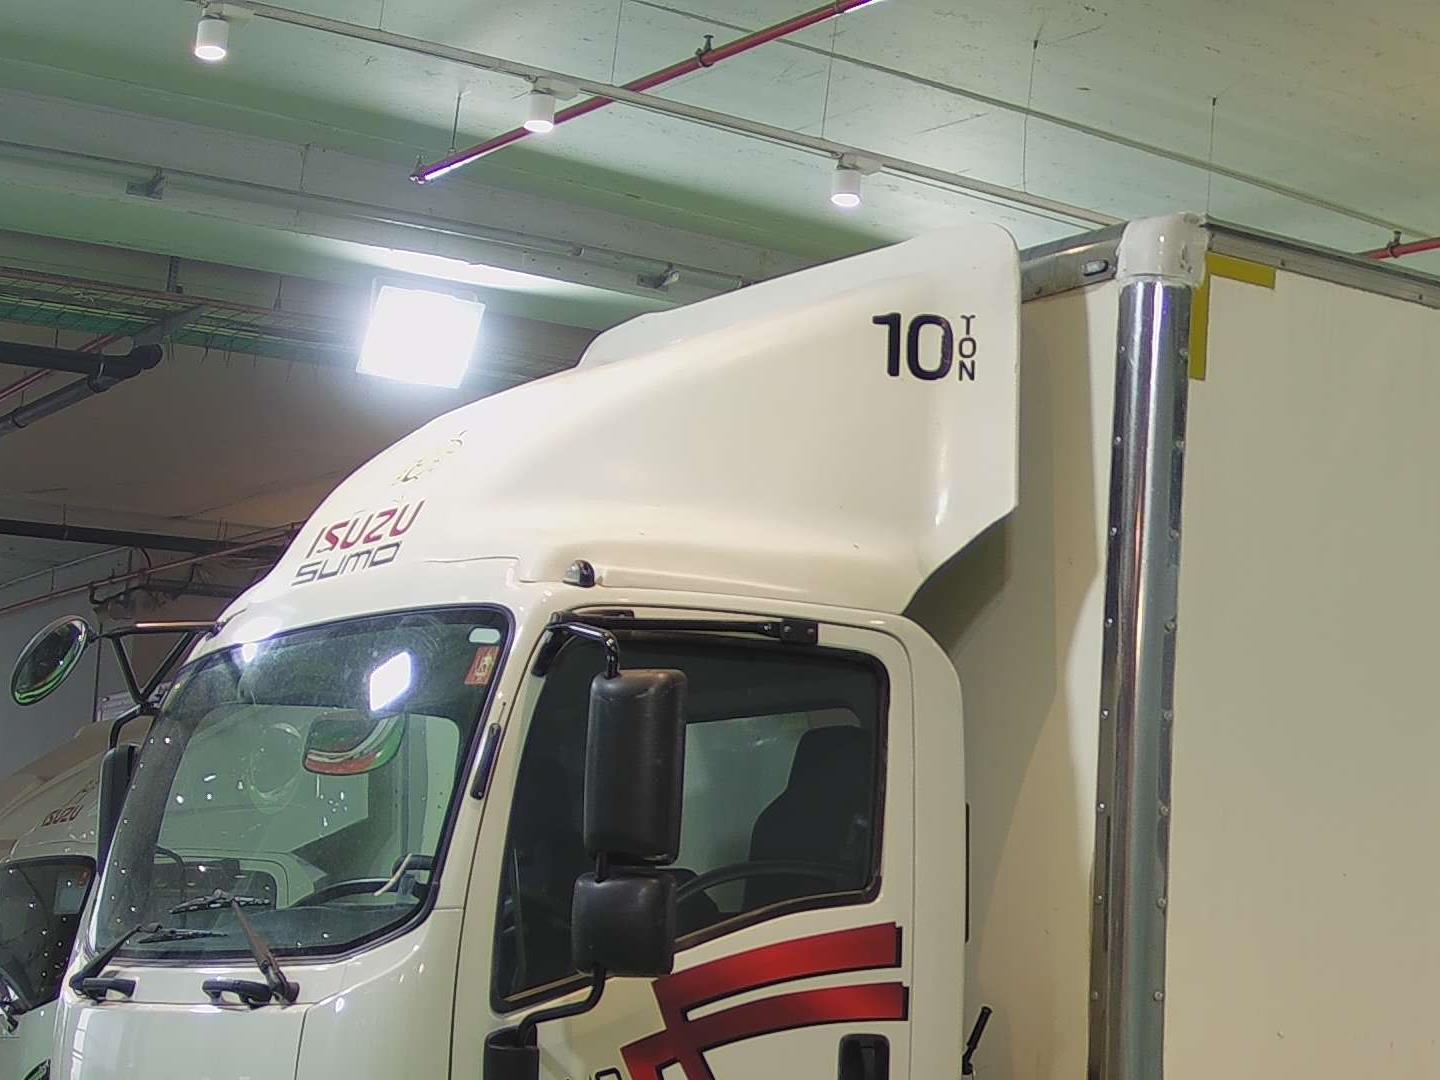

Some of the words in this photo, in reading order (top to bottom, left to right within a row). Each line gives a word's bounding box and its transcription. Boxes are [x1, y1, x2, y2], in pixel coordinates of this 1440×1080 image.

[872, 312, 953, 381] 10
[958, 314, 977, 381] TON
[305, 499, 426, 559] ISUZU
